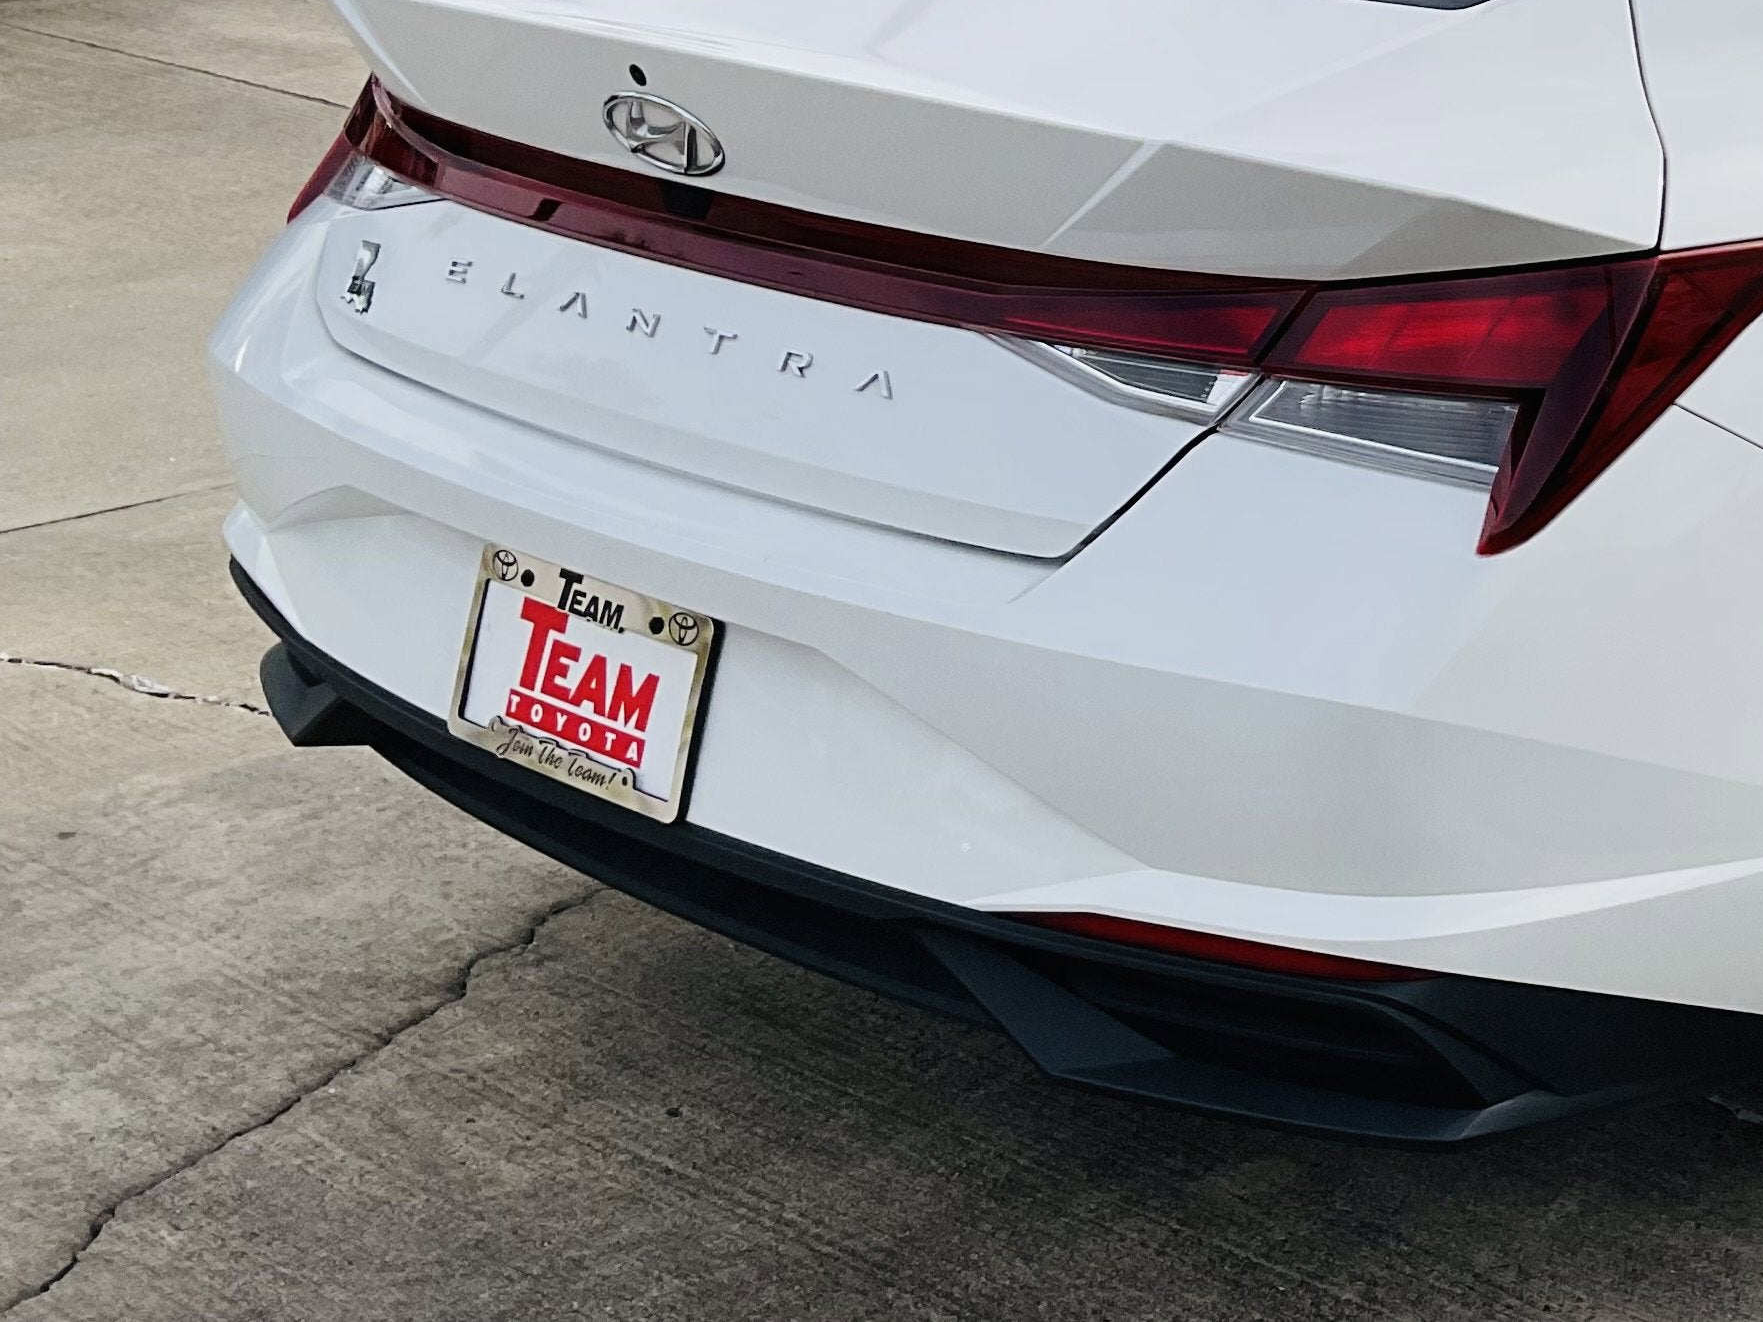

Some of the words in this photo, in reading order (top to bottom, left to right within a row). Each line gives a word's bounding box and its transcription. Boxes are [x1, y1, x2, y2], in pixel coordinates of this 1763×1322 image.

[444, 259, 894, 399] ELANTRA
[519, 596, 660, 733] TEAM
[495, 727, 533, 757] Join
[509, 694, 639, 763] TOYOTA
